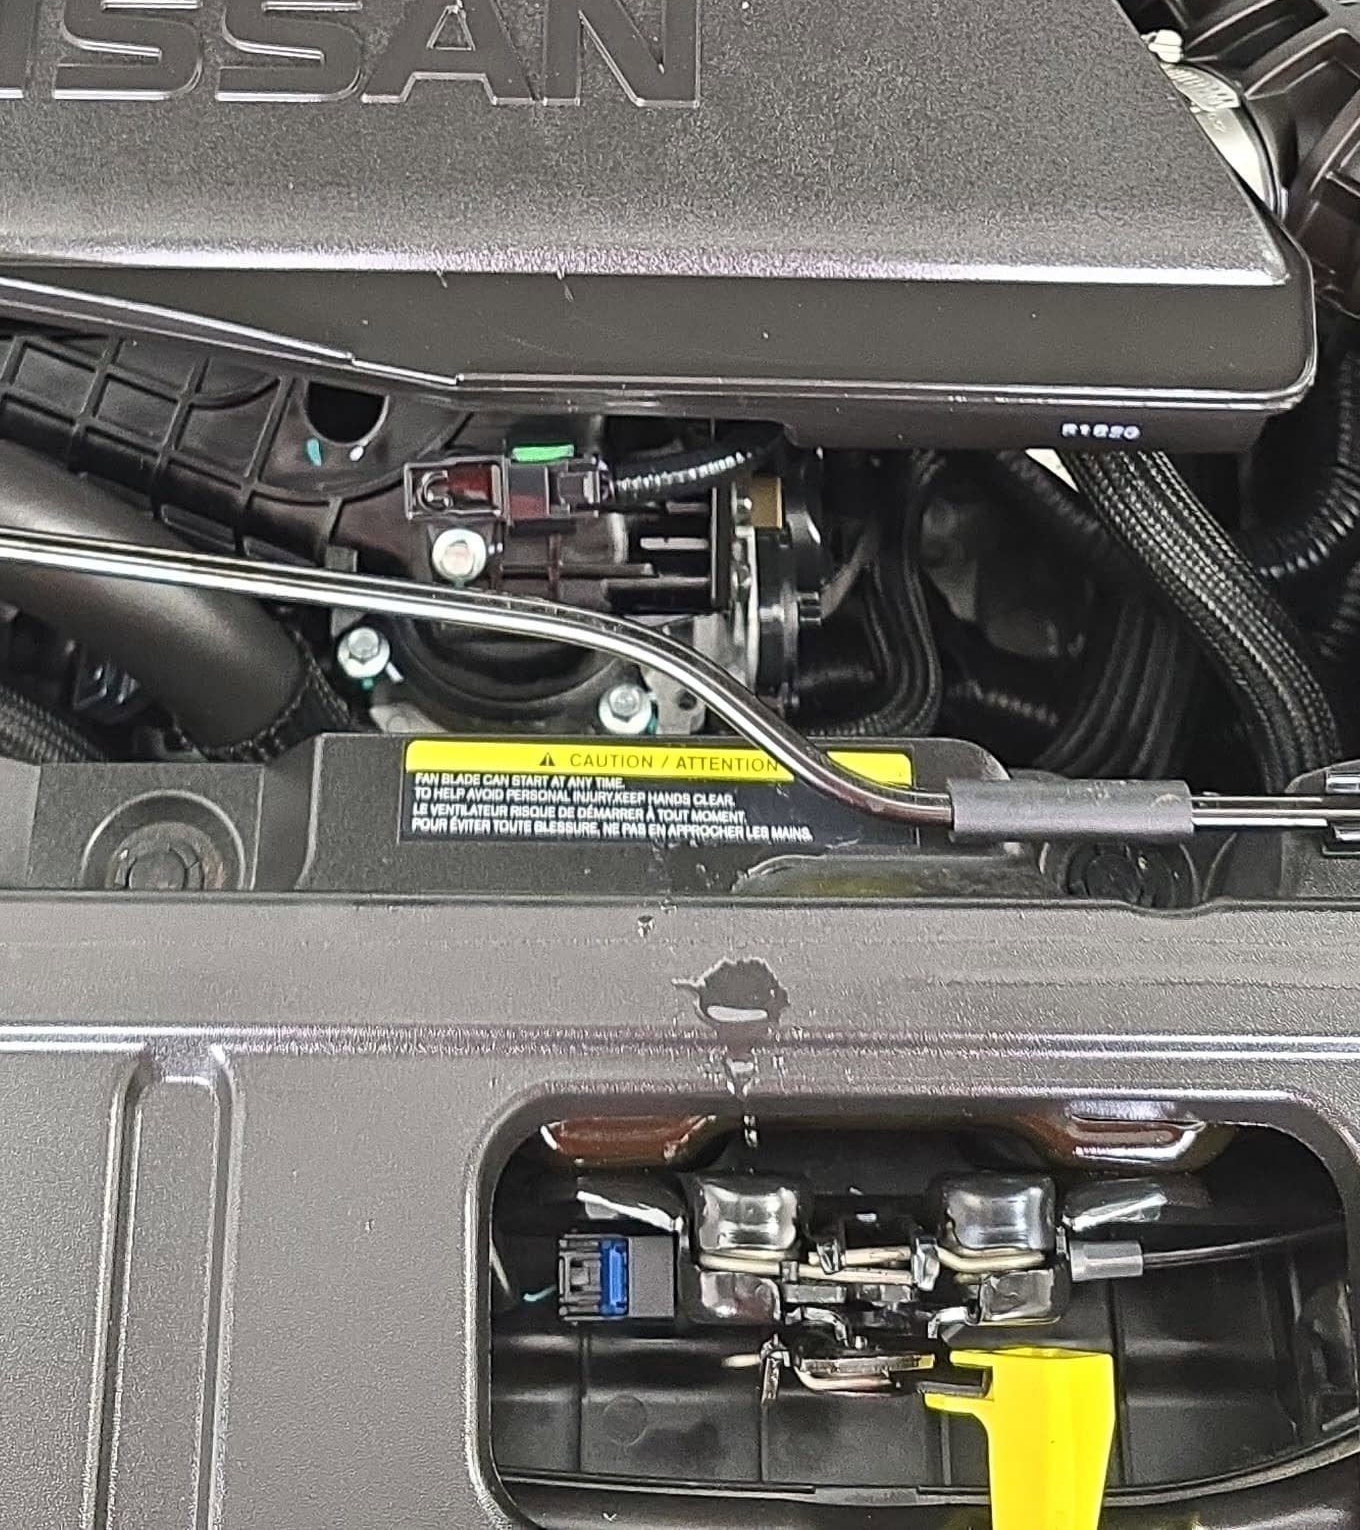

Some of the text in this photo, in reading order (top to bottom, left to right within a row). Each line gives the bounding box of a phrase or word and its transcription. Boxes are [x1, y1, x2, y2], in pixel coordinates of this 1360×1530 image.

[569, 753, 653, 768] CAUTION
[675, 756, 779, 772] ATTENTION
[414, 773, 626, 789] FAN BLADE CAN START AT ANY TIME.
[414, 787, 432, 801] TO
[434, 788, 465, 801] HELP
[466, 788, 504, 803] AVOID
[506, 789, 571, 804] PERSONAL
[648, 791, 691, 807] HANDS
[692, 792, 736, 808] CLEAR.
[413, 802, 429, 816] LE
[430, 803, 508, 818] VENTILATEUR
[509, 805, 556, 819] RISQUE
[558, 806, 576, 819] DE
[577, 804, 644, 821] DÉMARRER
[657, 809, 690, 823] TOUT
[411, 817, 448, 833] POUR
[450, 816, 491, 834] ÉVITER
[493, 820, 532, 834] TOUTE
[603, 822, 621, 837] NE
[622, 823, 646, 838] PAS
[648, 823, 666, 840] EN
[667, 824, 745, 842] APPROCHER
[746, 825, 769, 841] LES
